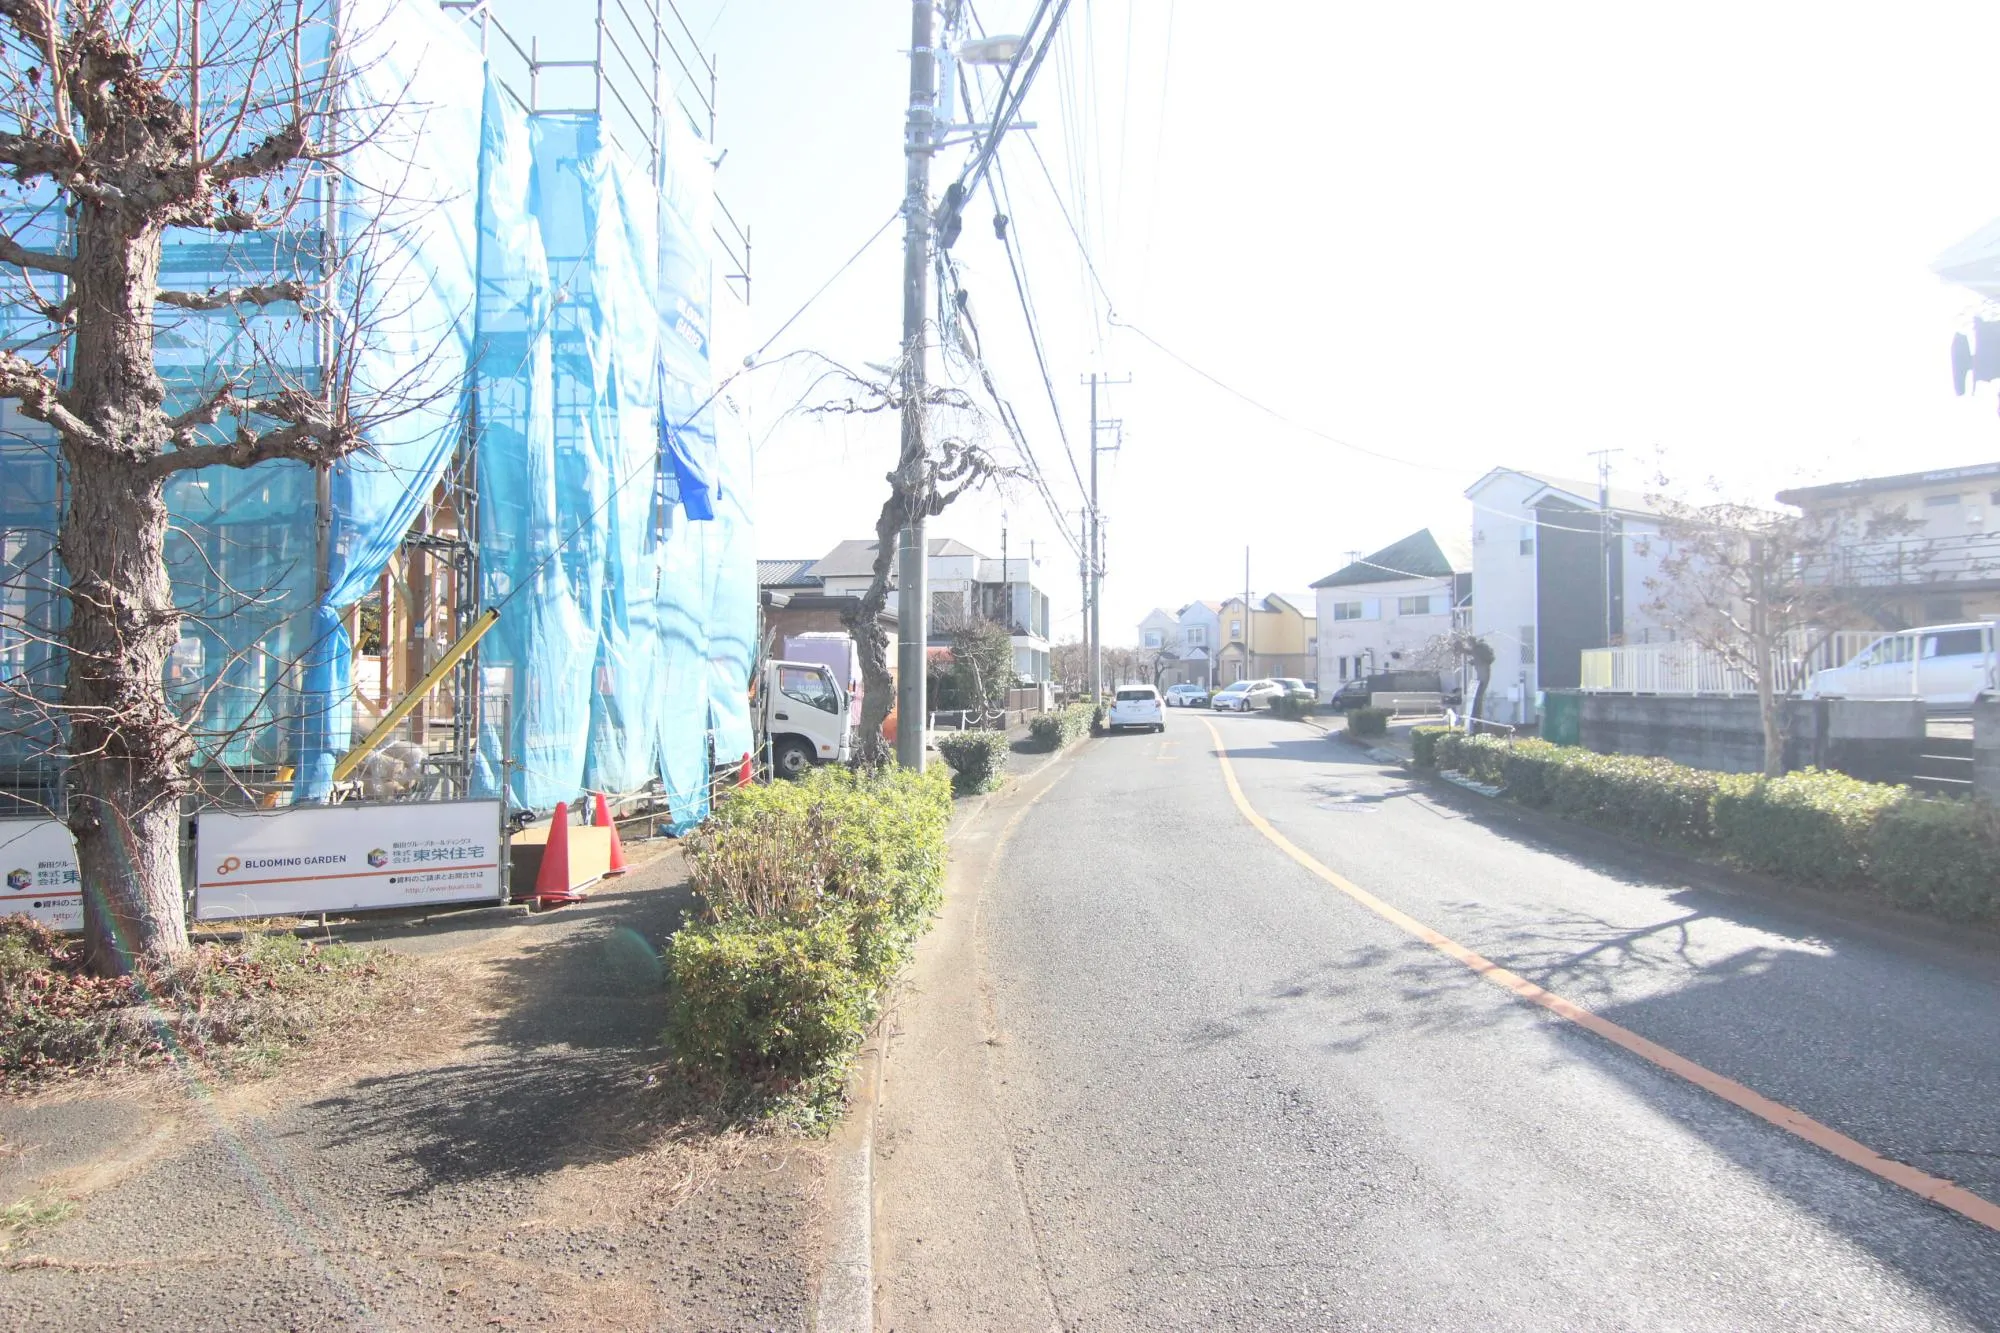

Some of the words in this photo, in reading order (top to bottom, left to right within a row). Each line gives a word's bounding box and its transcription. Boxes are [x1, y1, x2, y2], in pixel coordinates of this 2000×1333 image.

[413, 845, 485, 862] 東栄住宅
[245, 858, 302, 869] BLOOMING
[304, 855, 347, 865] GARDEN
